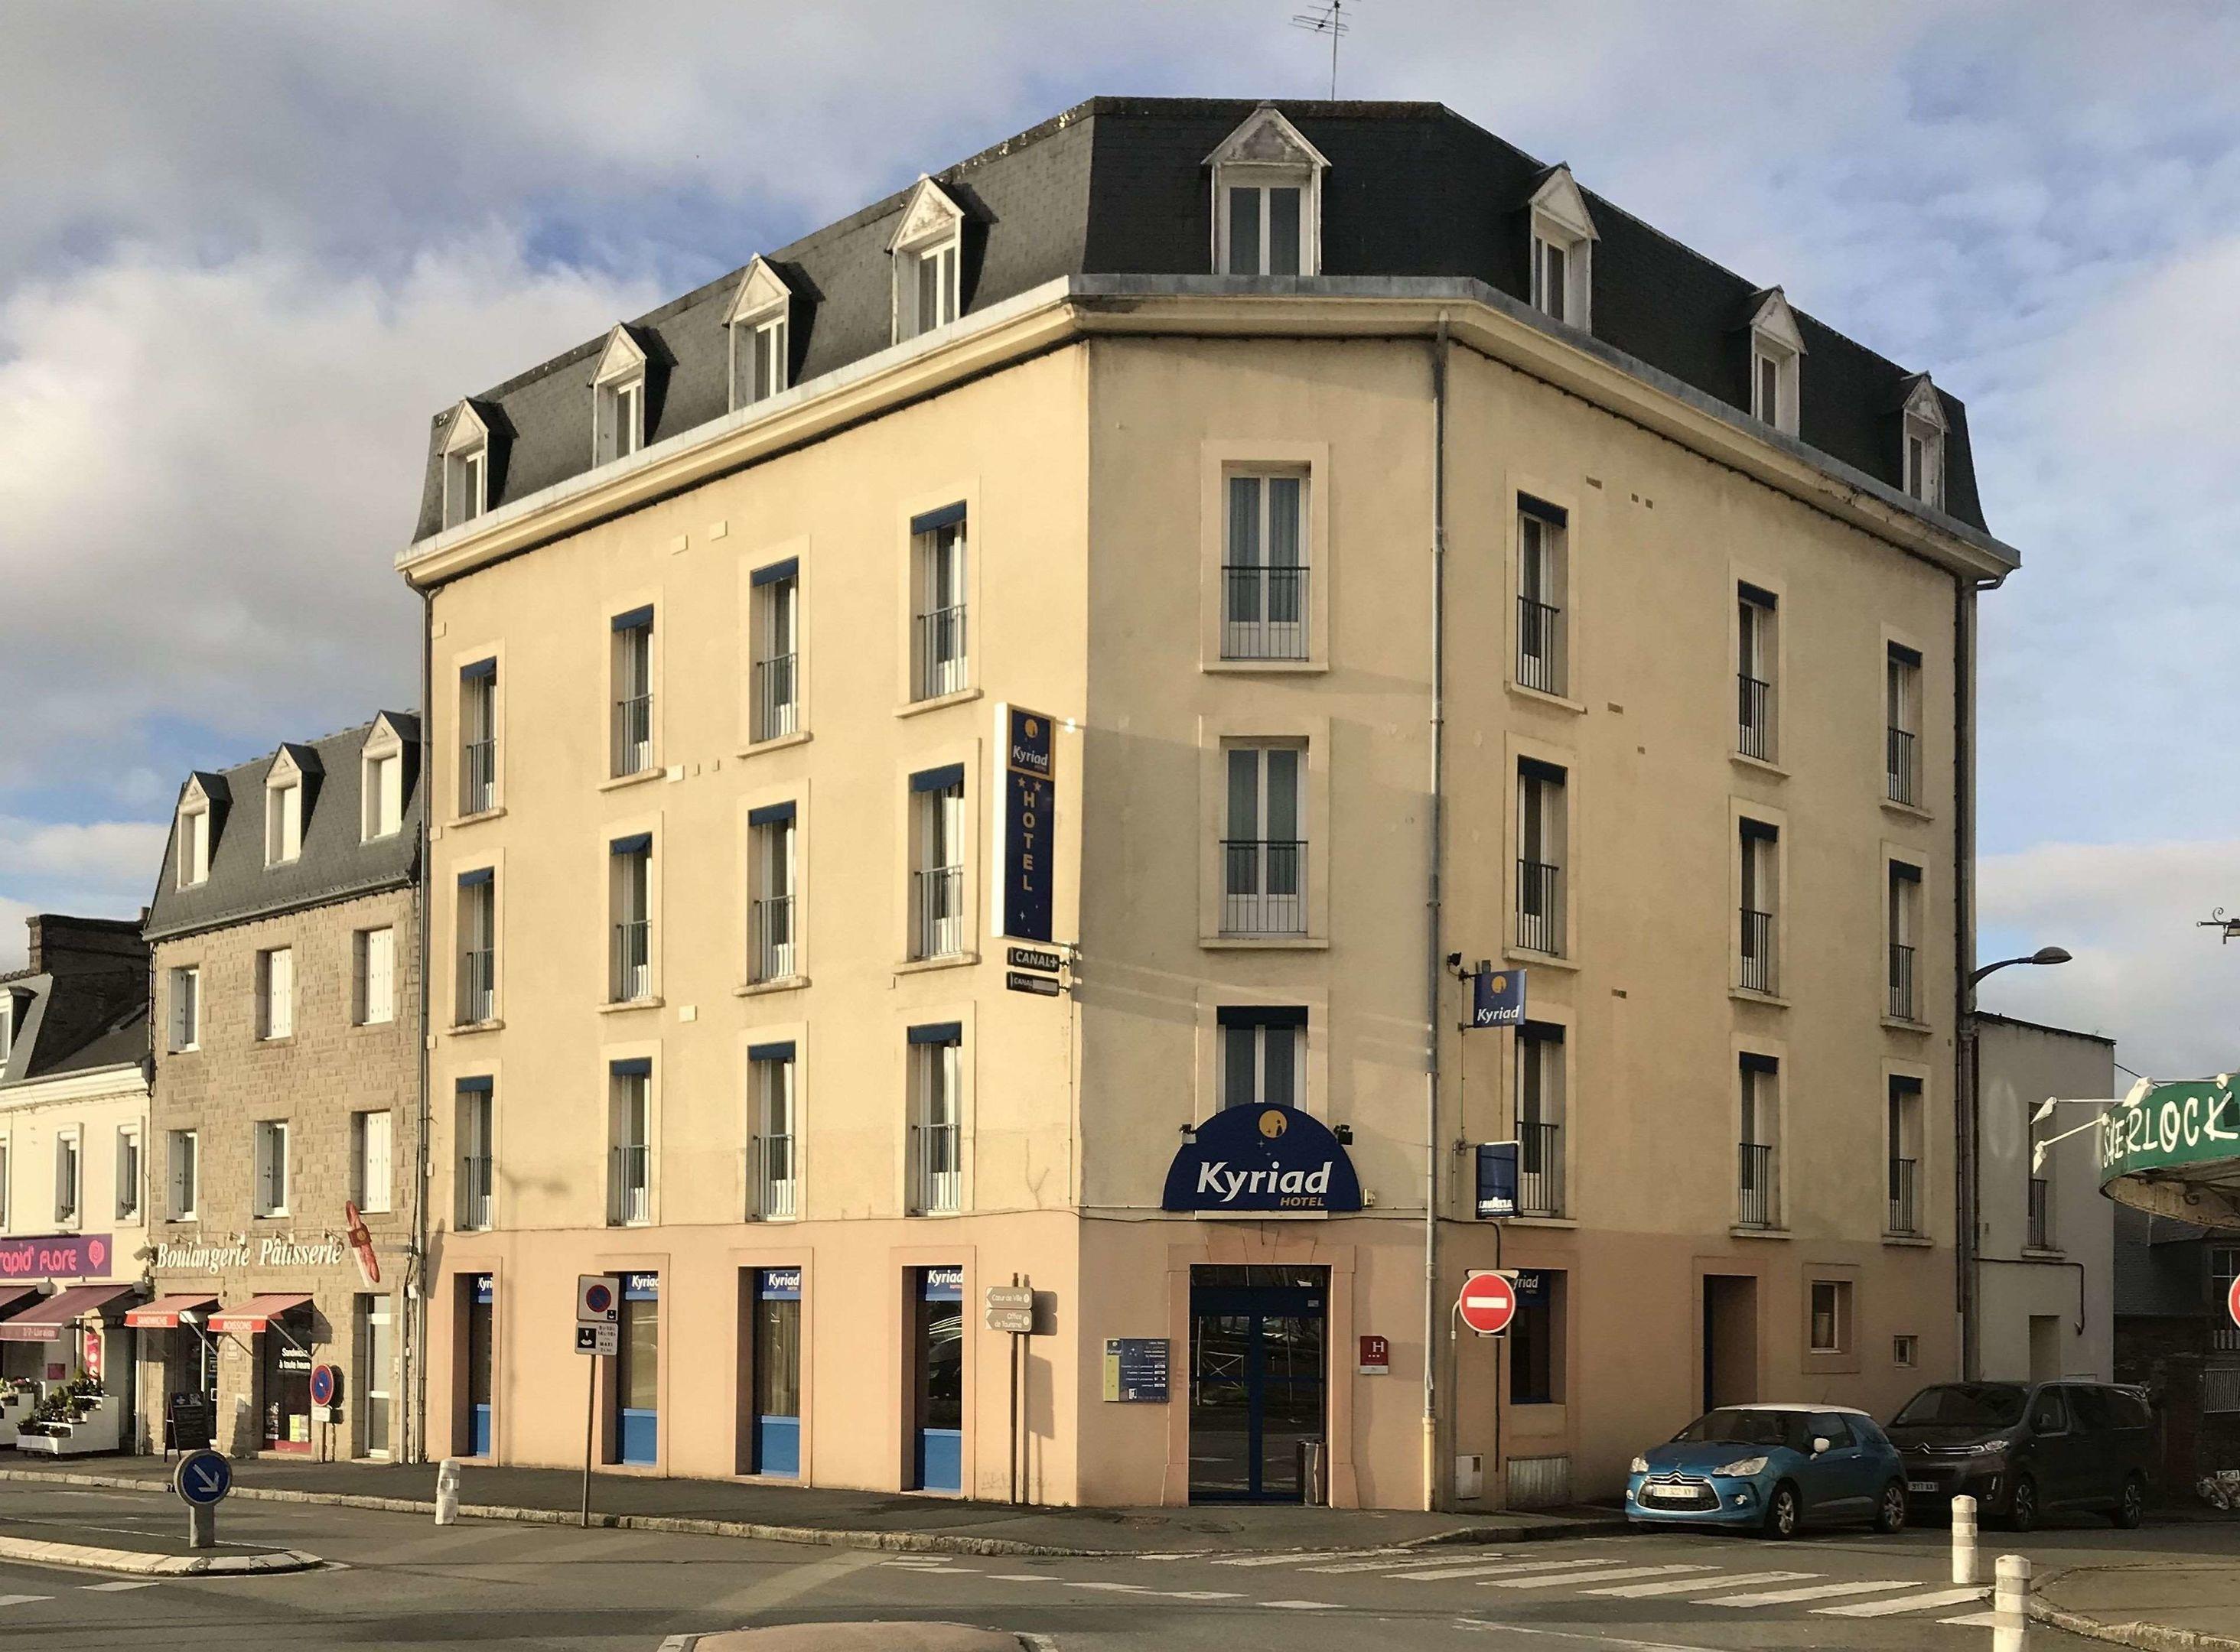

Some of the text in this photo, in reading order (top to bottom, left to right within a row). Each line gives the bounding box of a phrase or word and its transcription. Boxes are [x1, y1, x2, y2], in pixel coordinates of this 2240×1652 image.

[1013, 745, 1048, 766] Kyriad
[1022, 790, 1035, 892] HOTEL
[1016, 951, 1057, 967] CANAL+
[1477, 1004, 1520, 1024] Kyriad
[2104, 1091, 2238, 1169] SHERLOCK
[1197, 1161, 1333, 1202] Kyriad
[1280, 1197, 1324, 1207] HOTEL
[156, 1238, 344, 1275] Boulangerie Pâtisserie
[477, 1276, 493, 1291] Kyri
[768, 1273, 800, 1289] Kyriad
[927, 1270, 963, 1287] Kyriad
[1513, 1275, 1538, 1291] yriad
[1372, 1341, 1384, 1352] H
